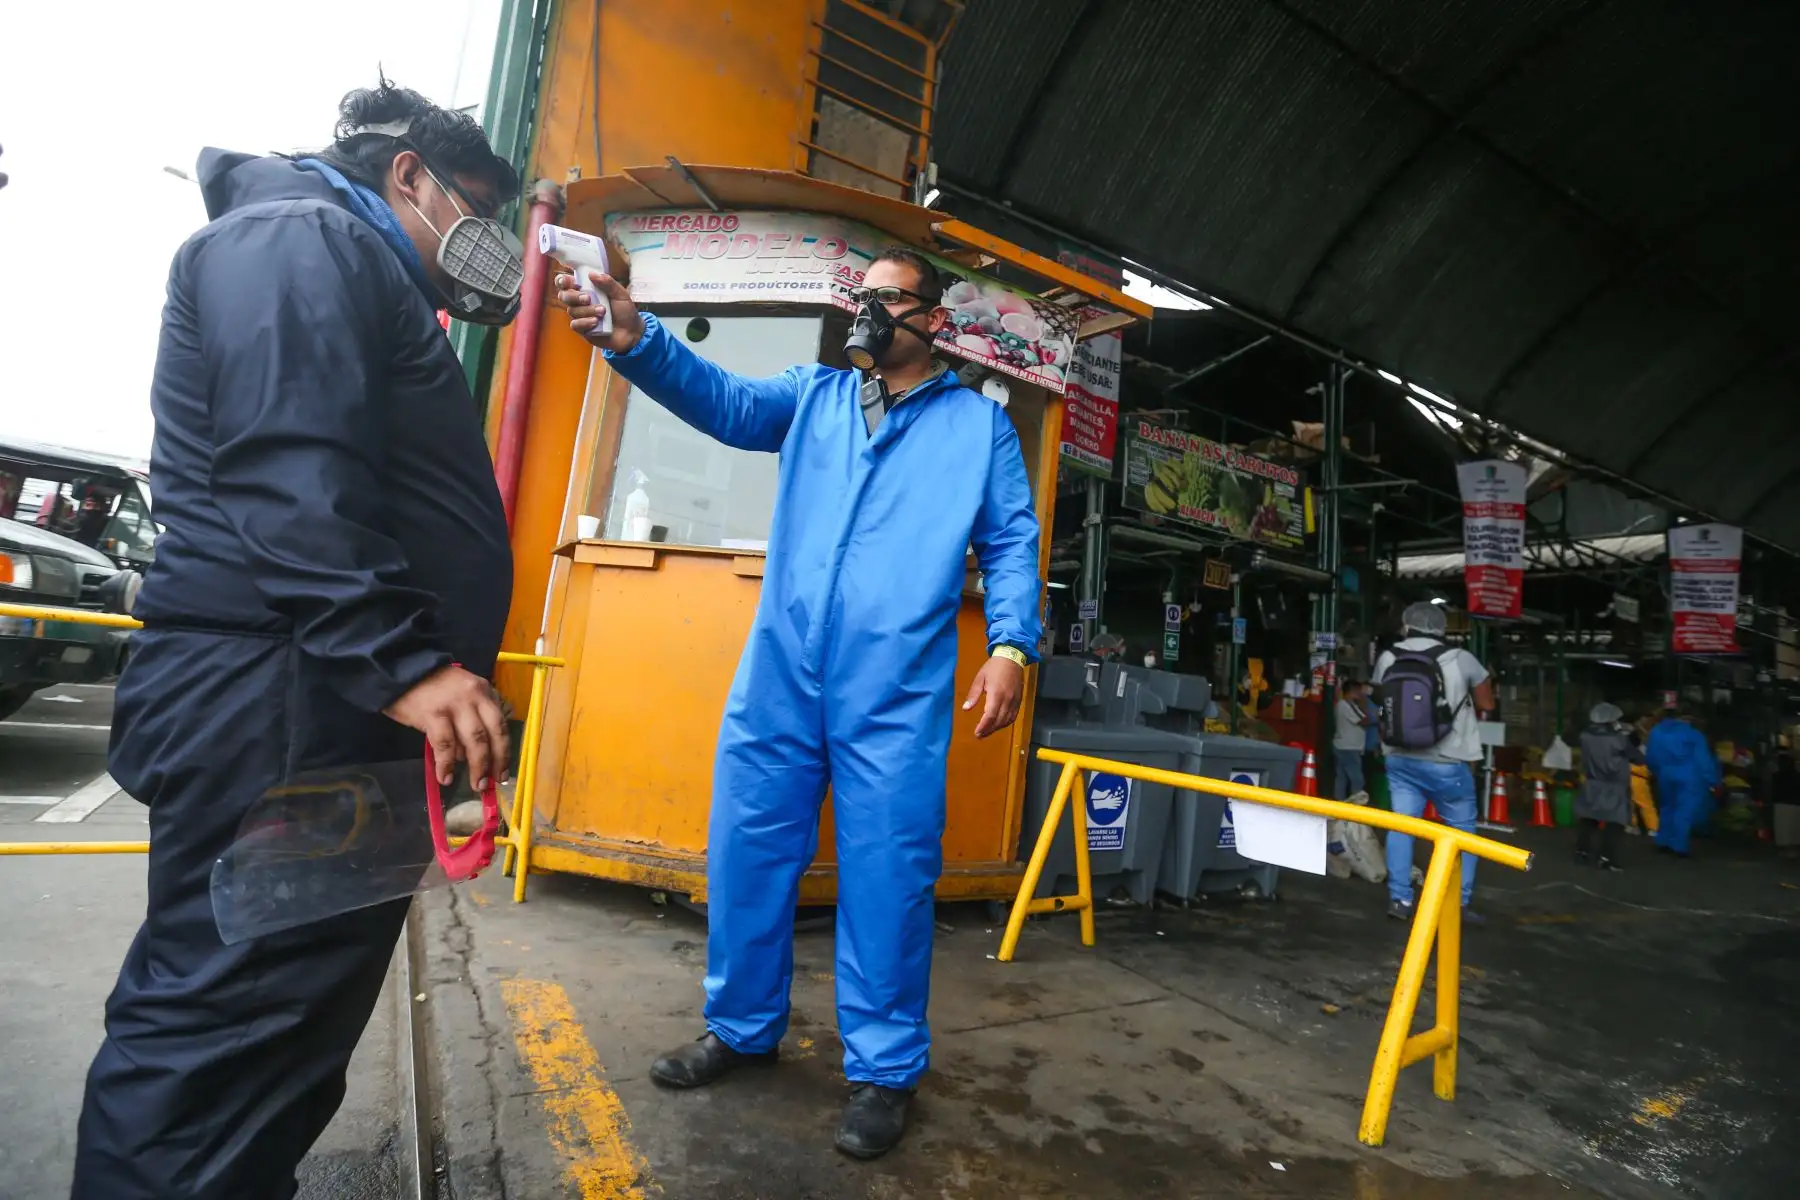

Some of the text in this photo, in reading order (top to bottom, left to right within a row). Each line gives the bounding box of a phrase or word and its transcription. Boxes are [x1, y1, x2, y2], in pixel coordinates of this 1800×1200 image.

[631, 214, 740, 232] MERCADO
[661, 233, 848, 260] MODELO
[683, 282, 726, 290] SOMOS
[730, 281, 824, 291] PRODUCTORES
[961, 348, 987, 364] MODELO
[987, 358, 997, 367] DE
[996, 360, 1019, 377] FRUTAS
[1018, 369, 1029, 379] DE
[1027, 372, 1036, 381] LA
[1035, 374, 1063, 391] VICTORIA
[1087, 370, 1113, 389] USAR:
[1139, 422, 1223, 463] BANANAS
[1225, 450, 1299, 486] CARLITOS
[1206, 564, 1229, 585] 307
